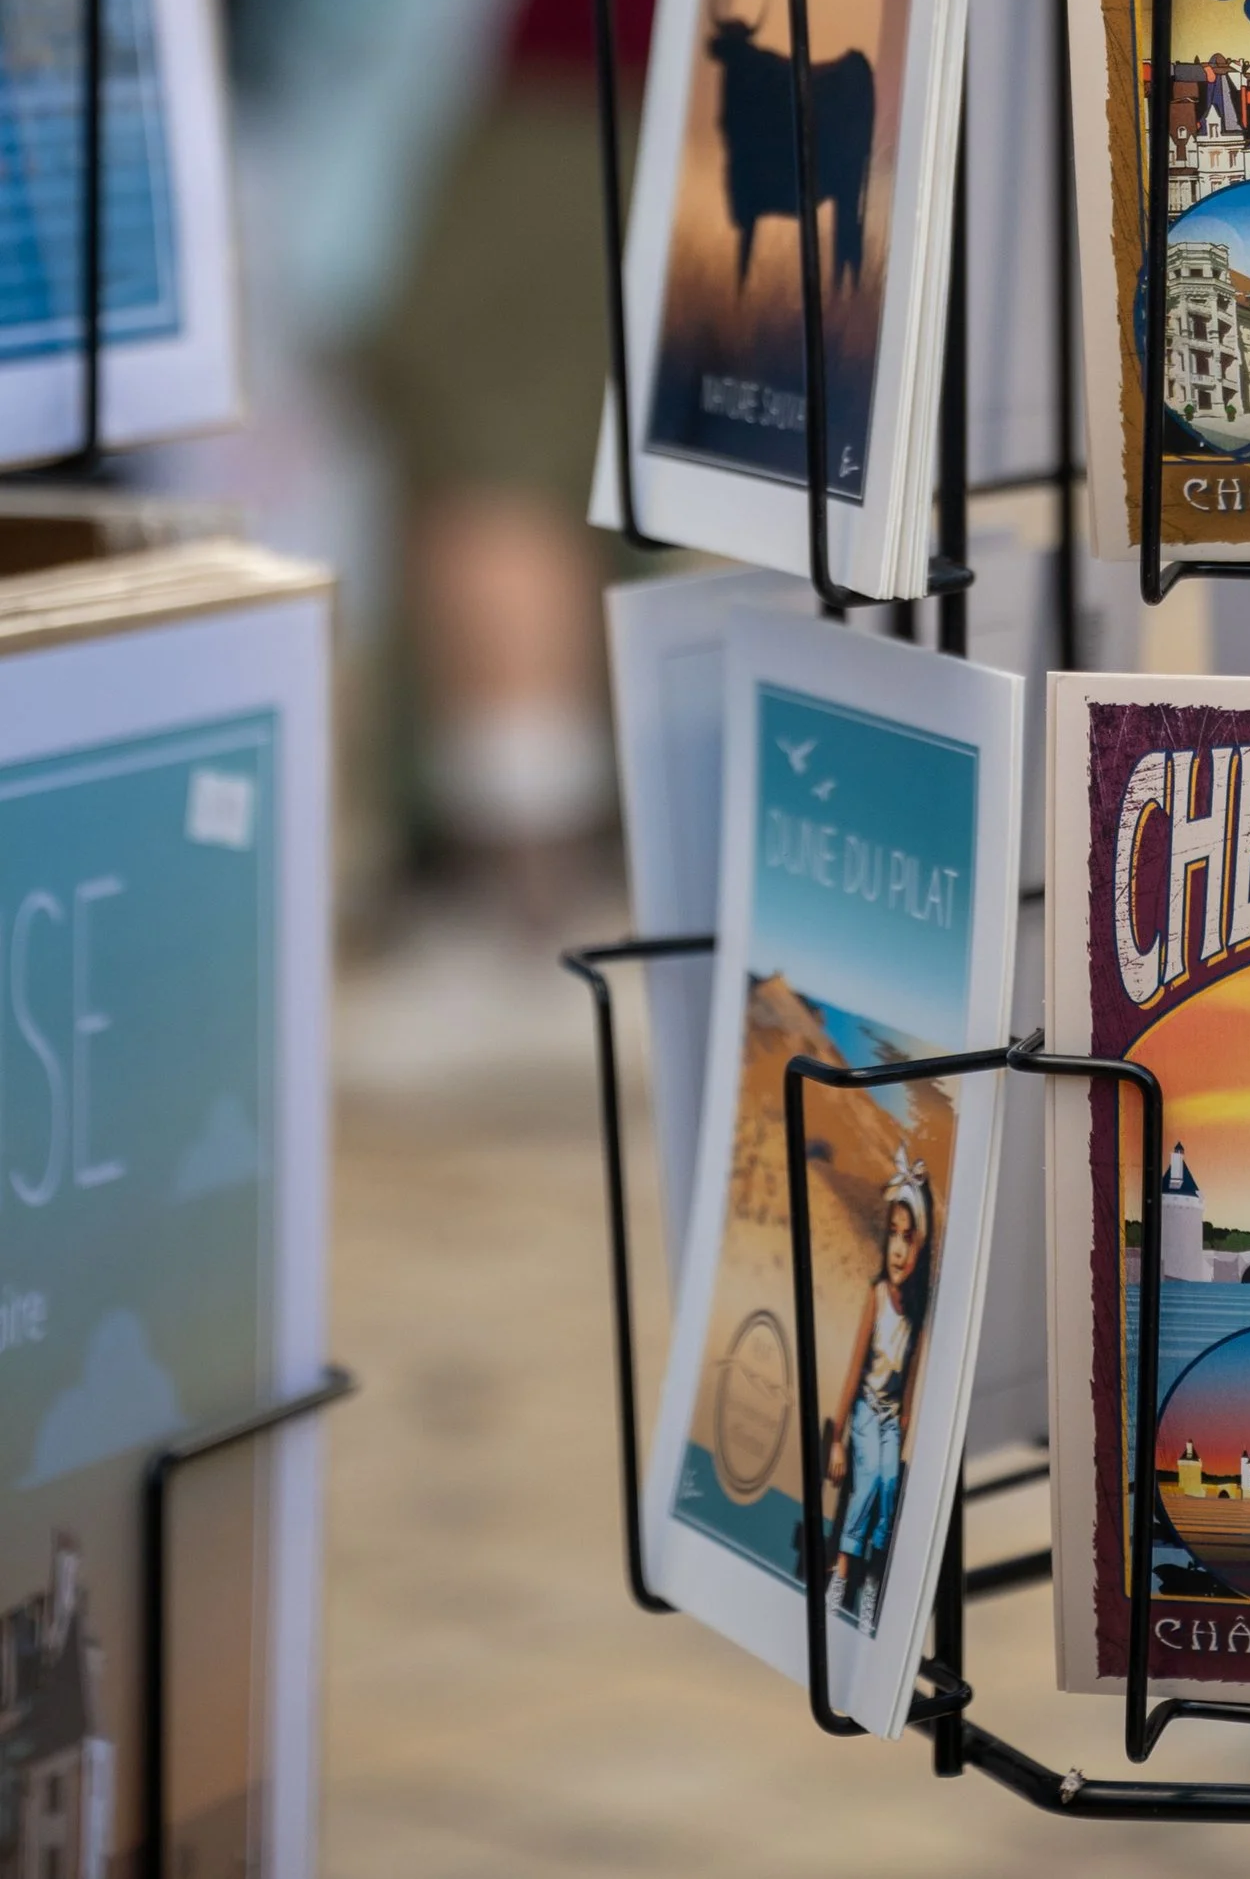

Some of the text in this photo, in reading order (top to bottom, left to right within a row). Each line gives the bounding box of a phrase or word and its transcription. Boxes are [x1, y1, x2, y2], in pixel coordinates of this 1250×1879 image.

[766, 808, 960, 930] DUNE DU PILAT
